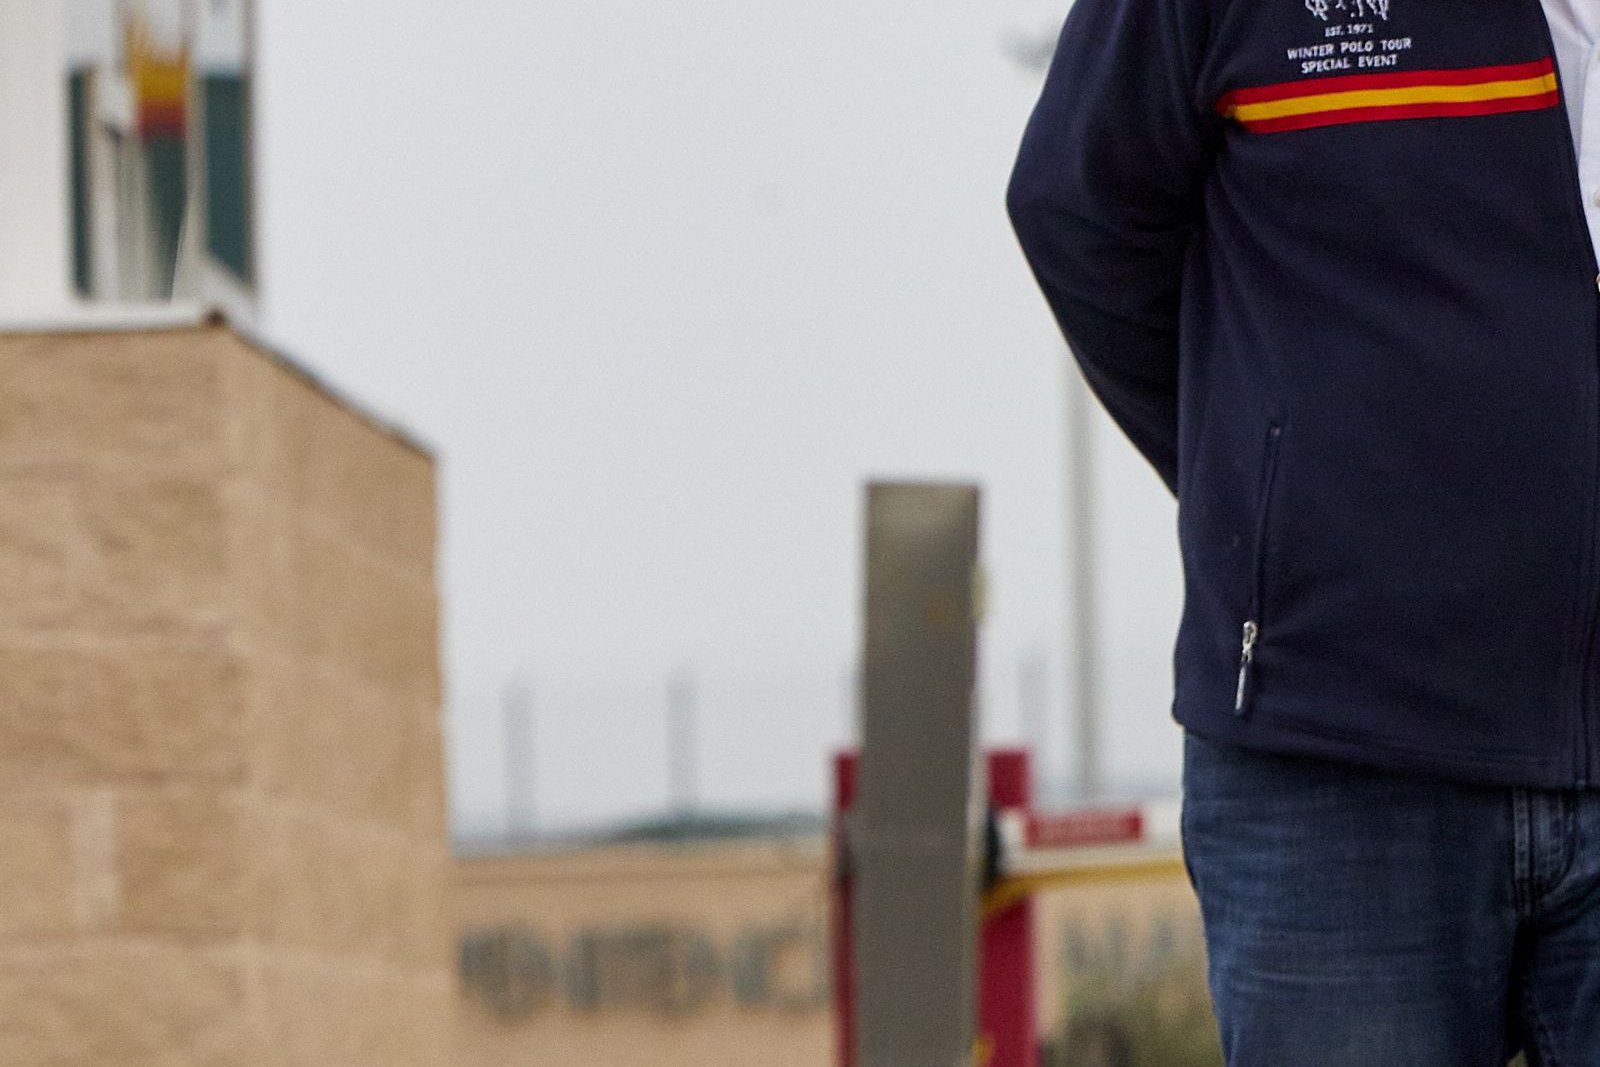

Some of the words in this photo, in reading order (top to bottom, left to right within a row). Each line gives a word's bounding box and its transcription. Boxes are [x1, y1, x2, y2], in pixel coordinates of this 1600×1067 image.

[1347, 24, 1373, 34] 1971
[1287, 43, 1334, 60] WINTER
[1340, 40, 1373, 53] POLO
[1380, 37, 1412, 51] TOUR
[1301, 56, 1350, 74] SPECIAL
[1358, 54, 1398, 68] EVENT
